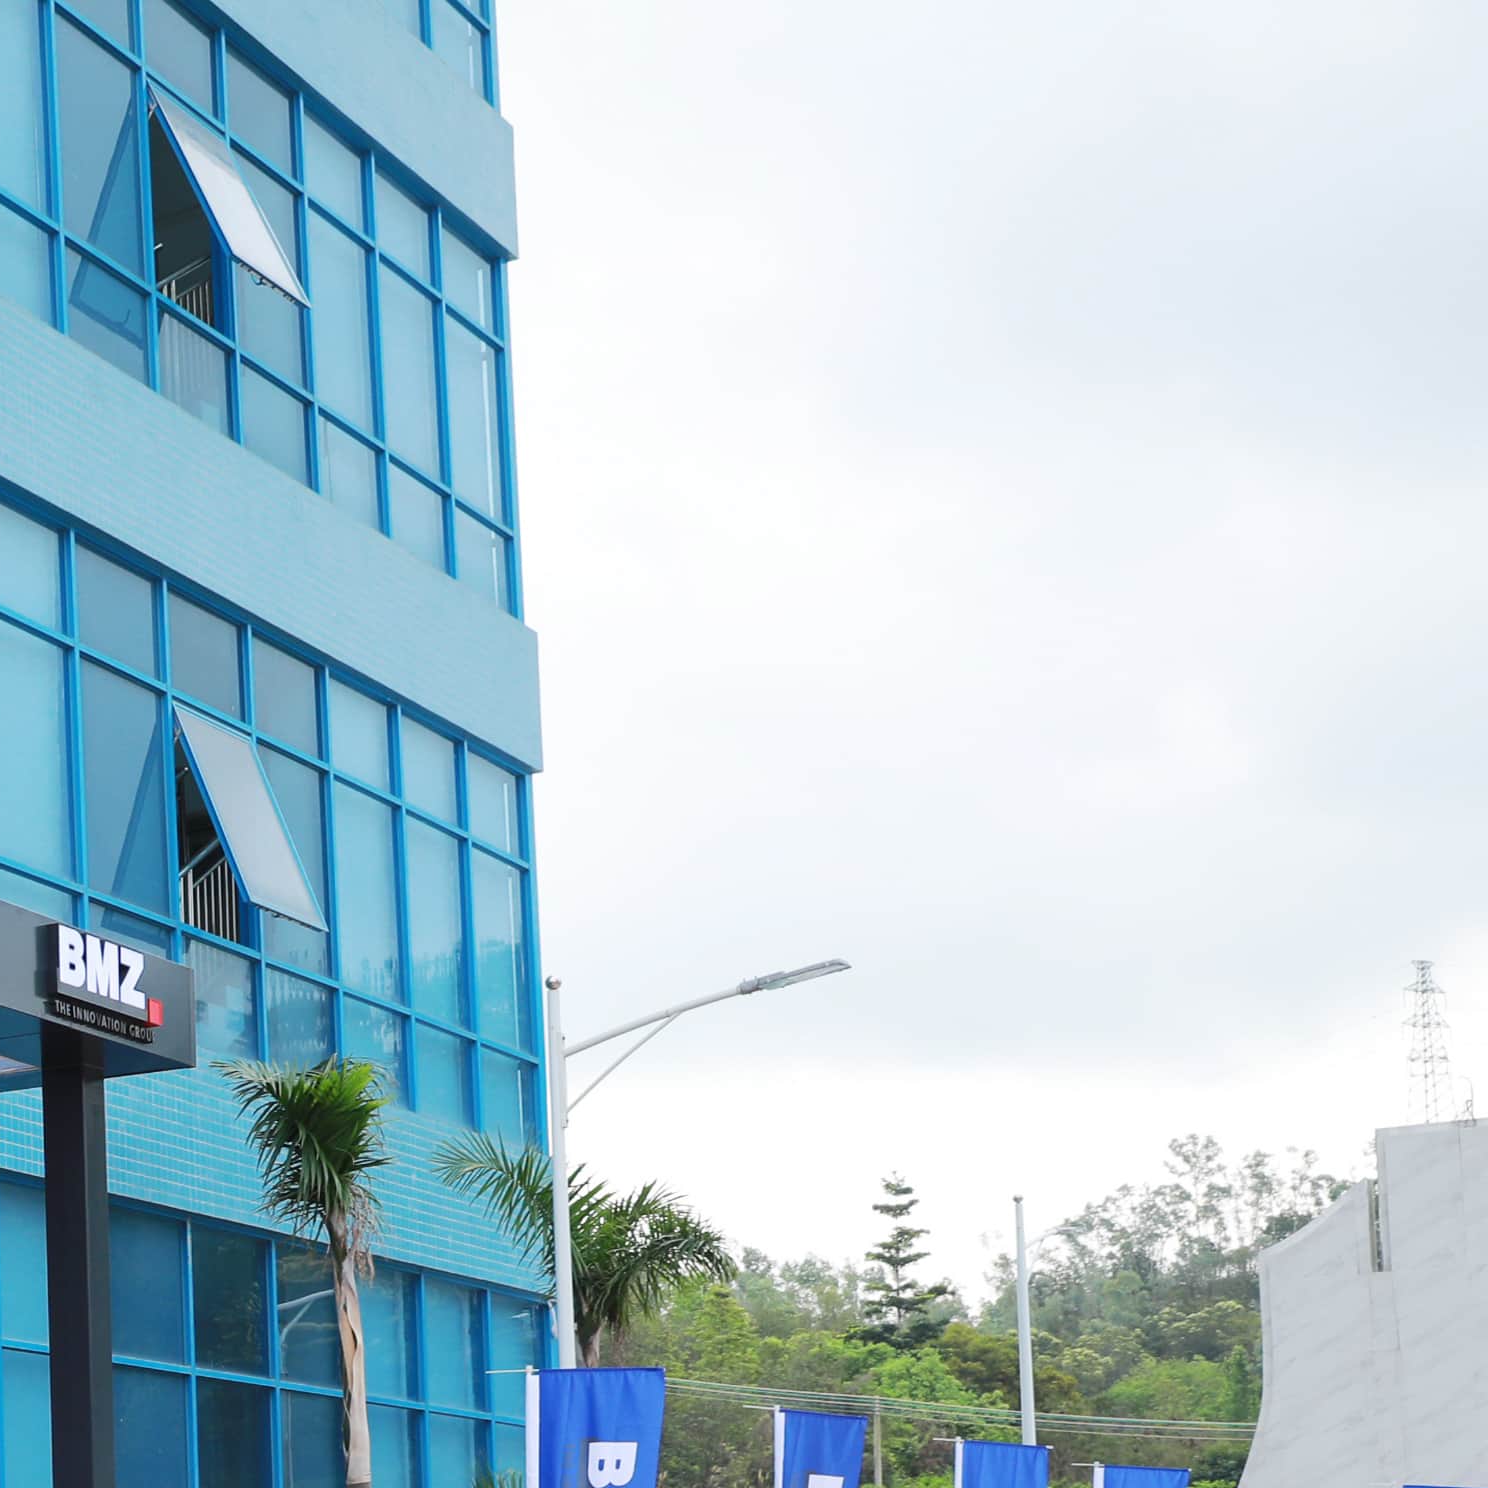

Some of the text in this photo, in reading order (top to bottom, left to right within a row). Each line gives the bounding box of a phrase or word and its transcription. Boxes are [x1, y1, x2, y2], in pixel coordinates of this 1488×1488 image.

[57, 924, 146, 1010] BMZ
[54, 999, 71, 1017] THE
[72, 1005, 127, 1034] INNOVATION
